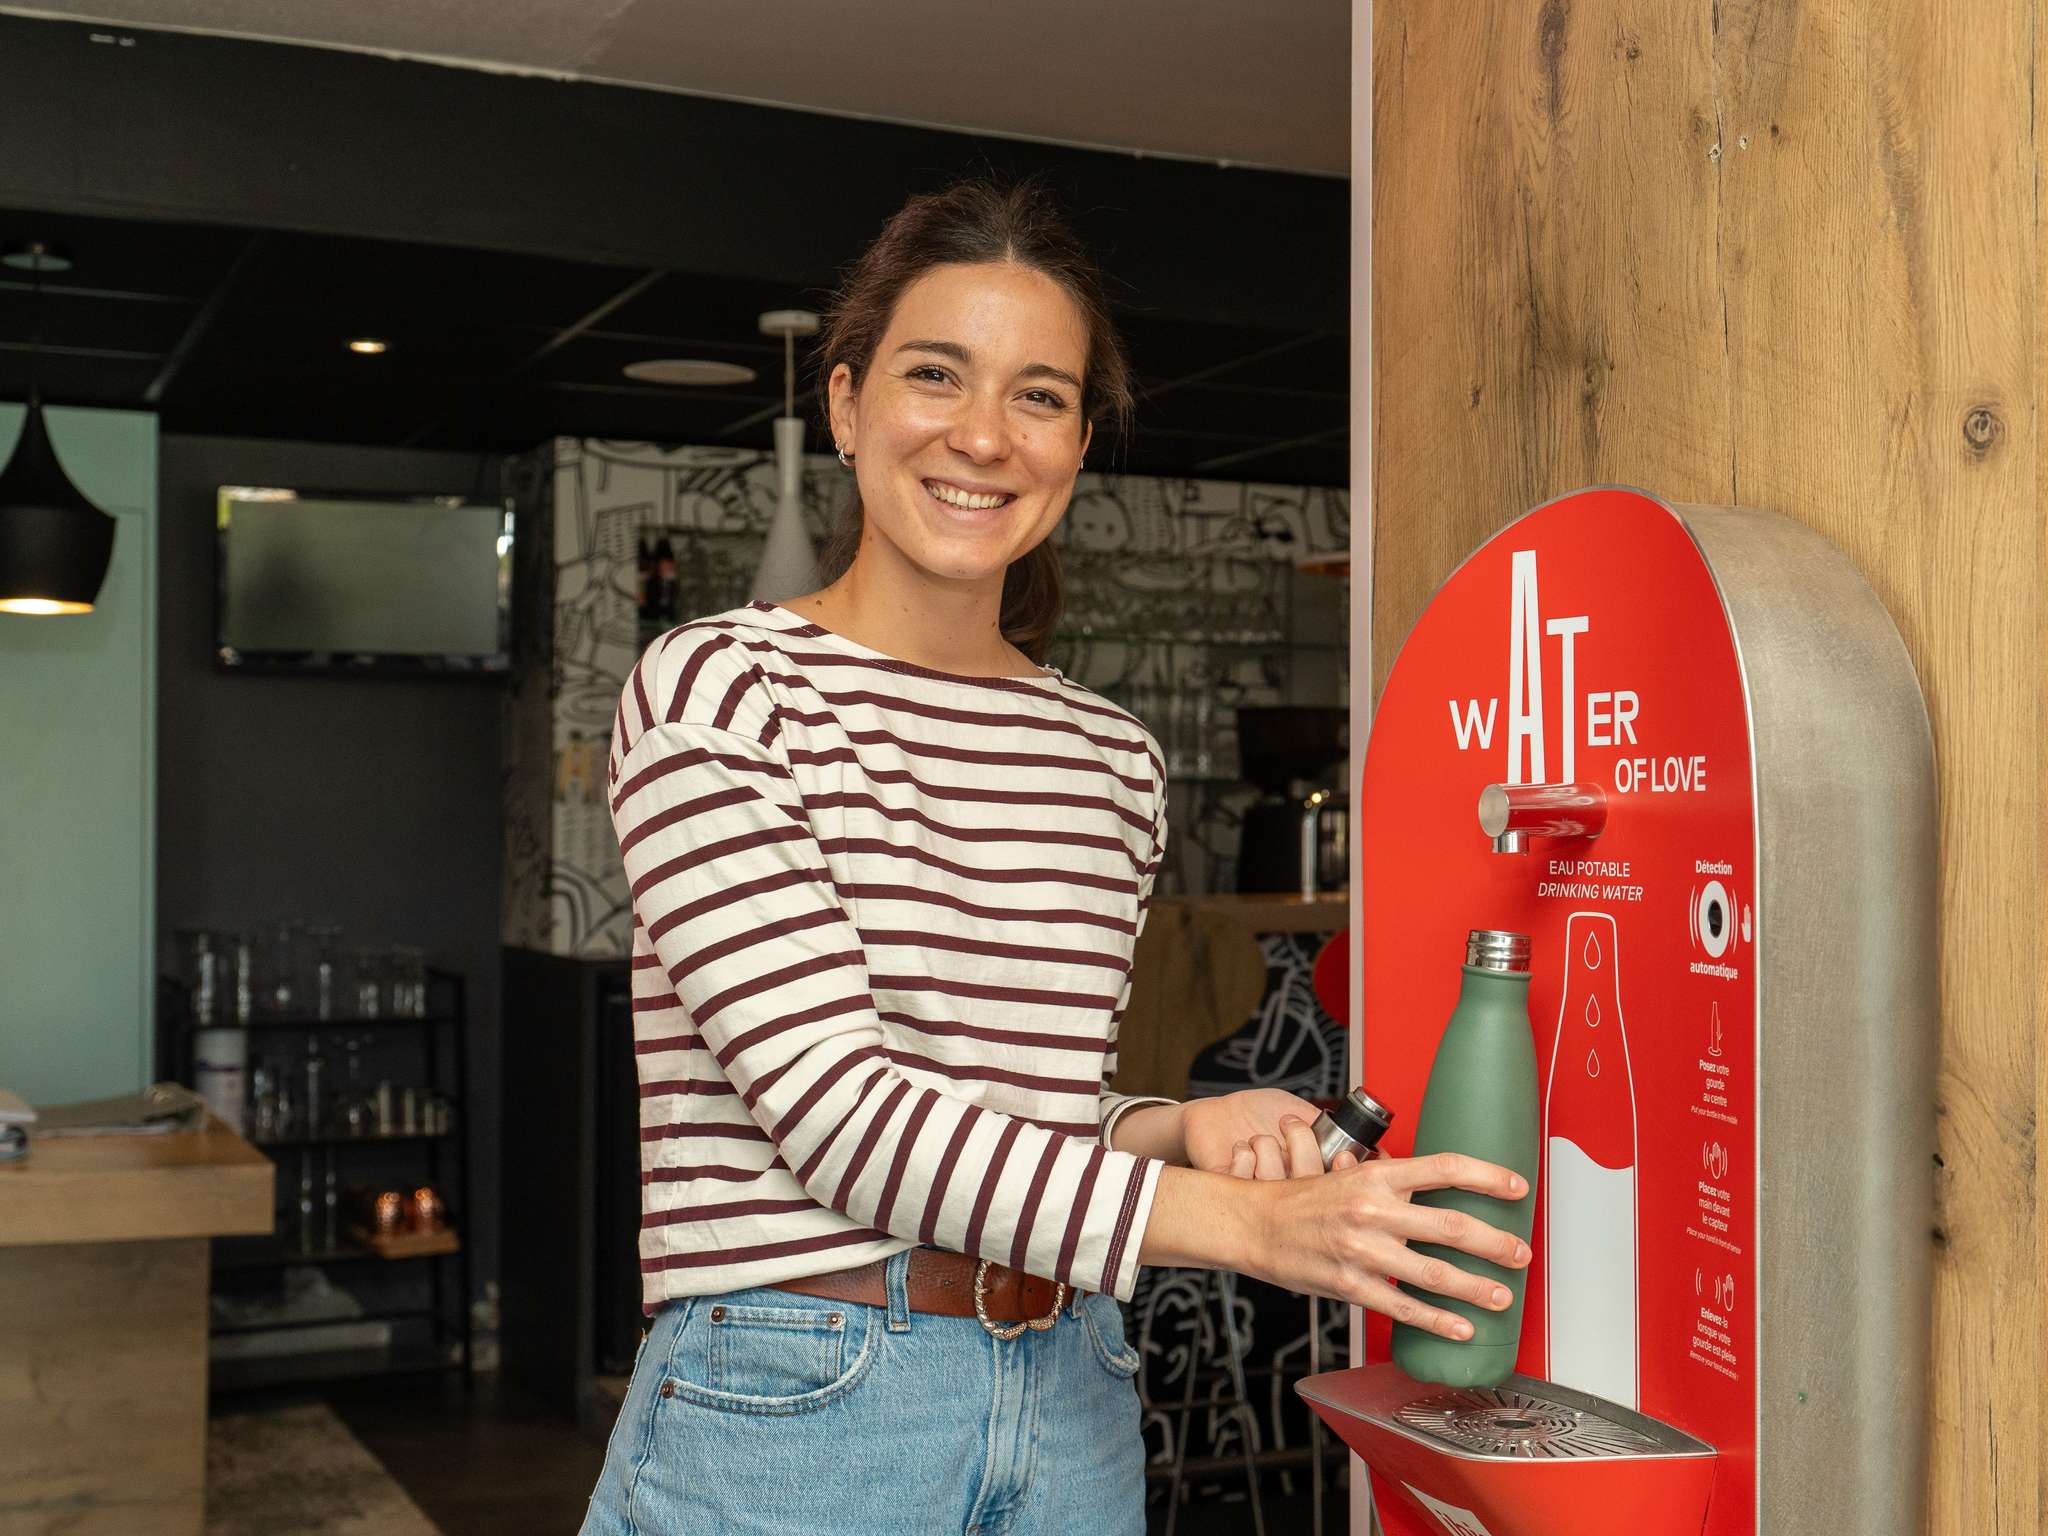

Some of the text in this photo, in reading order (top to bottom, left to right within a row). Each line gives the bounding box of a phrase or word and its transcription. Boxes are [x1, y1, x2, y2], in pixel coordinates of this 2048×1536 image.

[1448, 550, 1640, 785] WATER
[1614, 755, 1706, 793] OF LOVE
[1549, 860, 1631, 877] EAU POTABLE
[1695, 859, 1733, 876] Détection
[1538, 882, 1644, 901] DRINKING WATER
[1690, 961, 1738, 981] automatique
[1699, 1059, 1730, 1077] Posez votre
[1705, 1078, 1725, 1091] gourde
[1703, 1092, 1728, 1107] au centre
[1698, 1181, 1731, 1202] Placez votre
[1698, 1198, 1730, 1218] main devant
[1702, 1212, 1728, 1233] le capteur
[1700, 1307, 1728, 1329] Enlevez-la
[1697, 1320, 1731, 1347] lorsque votre
[1692, 1336, 1737, 1366] gourde est pleine
